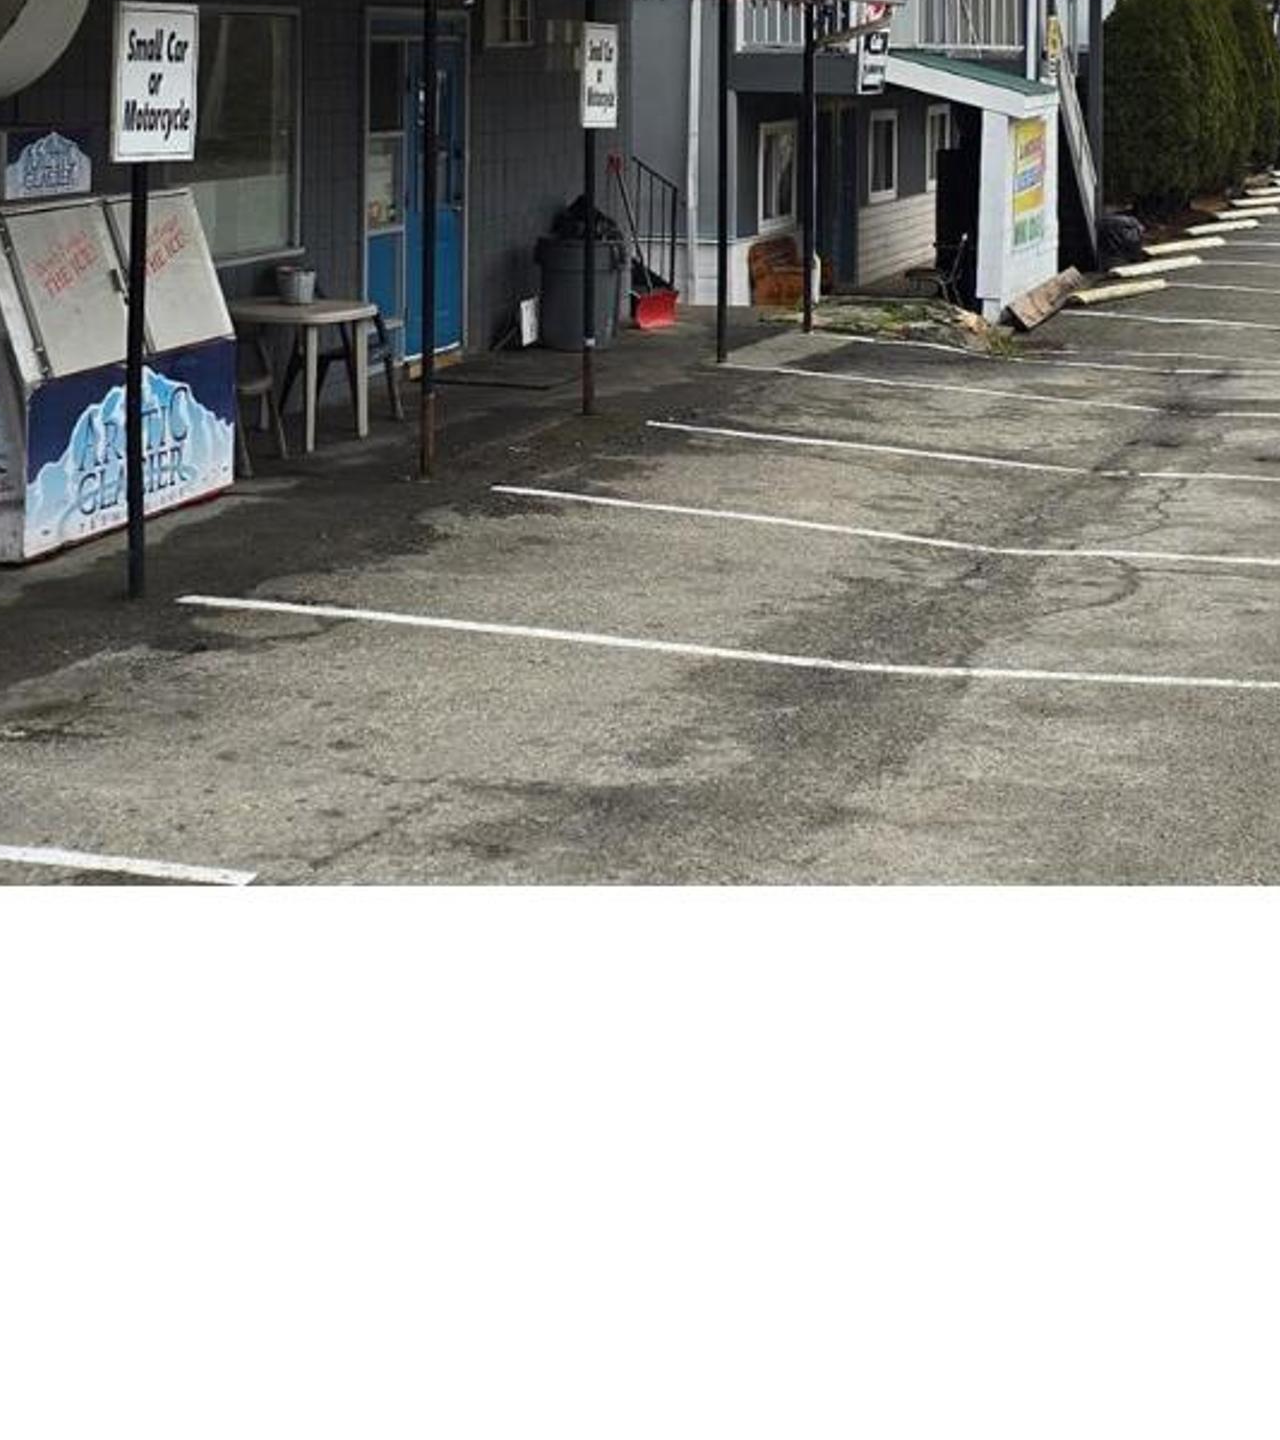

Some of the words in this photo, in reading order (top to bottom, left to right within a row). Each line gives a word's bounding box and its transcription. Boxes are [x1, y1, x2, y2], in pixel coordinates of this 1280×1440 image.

[127, 28, 164, 63] Small
[166, 31, 189, 63] Car
[148, 72, 163, 96] or
[123, 98, 191, 141] Motorcycle
[76, 385, 188, 473] ARTIC
